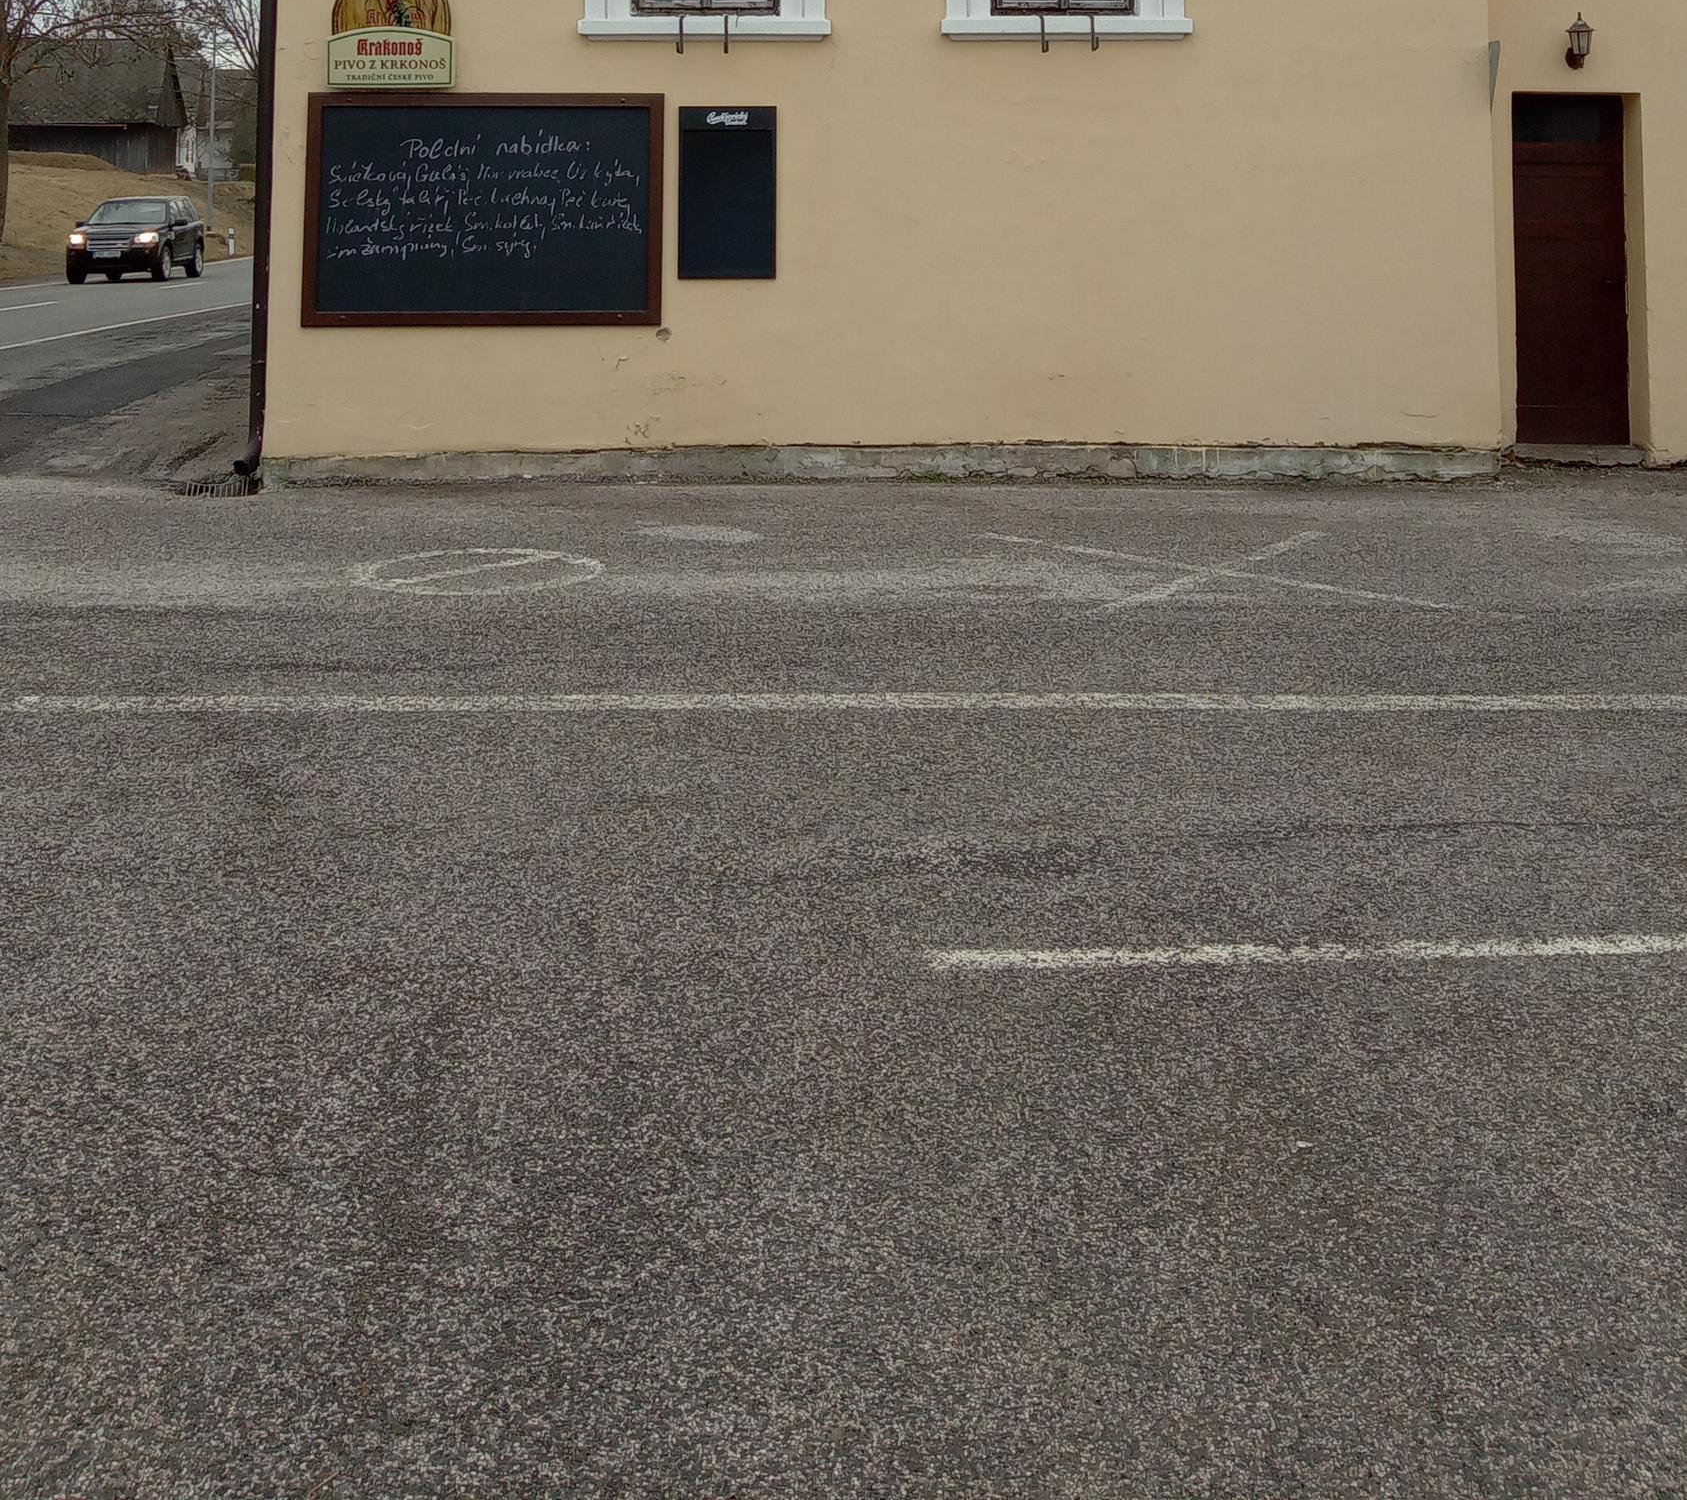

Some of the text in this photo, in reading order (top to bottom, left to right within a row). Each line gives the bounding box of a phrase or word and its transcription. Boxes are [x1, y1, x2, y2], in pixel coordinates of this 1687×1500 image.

[356, 38, 424, 56] Krakonoš
[334, 57, 447, 70] PIVO Z KRKONOŠ
[414, 73, 434, 81] PIVO
